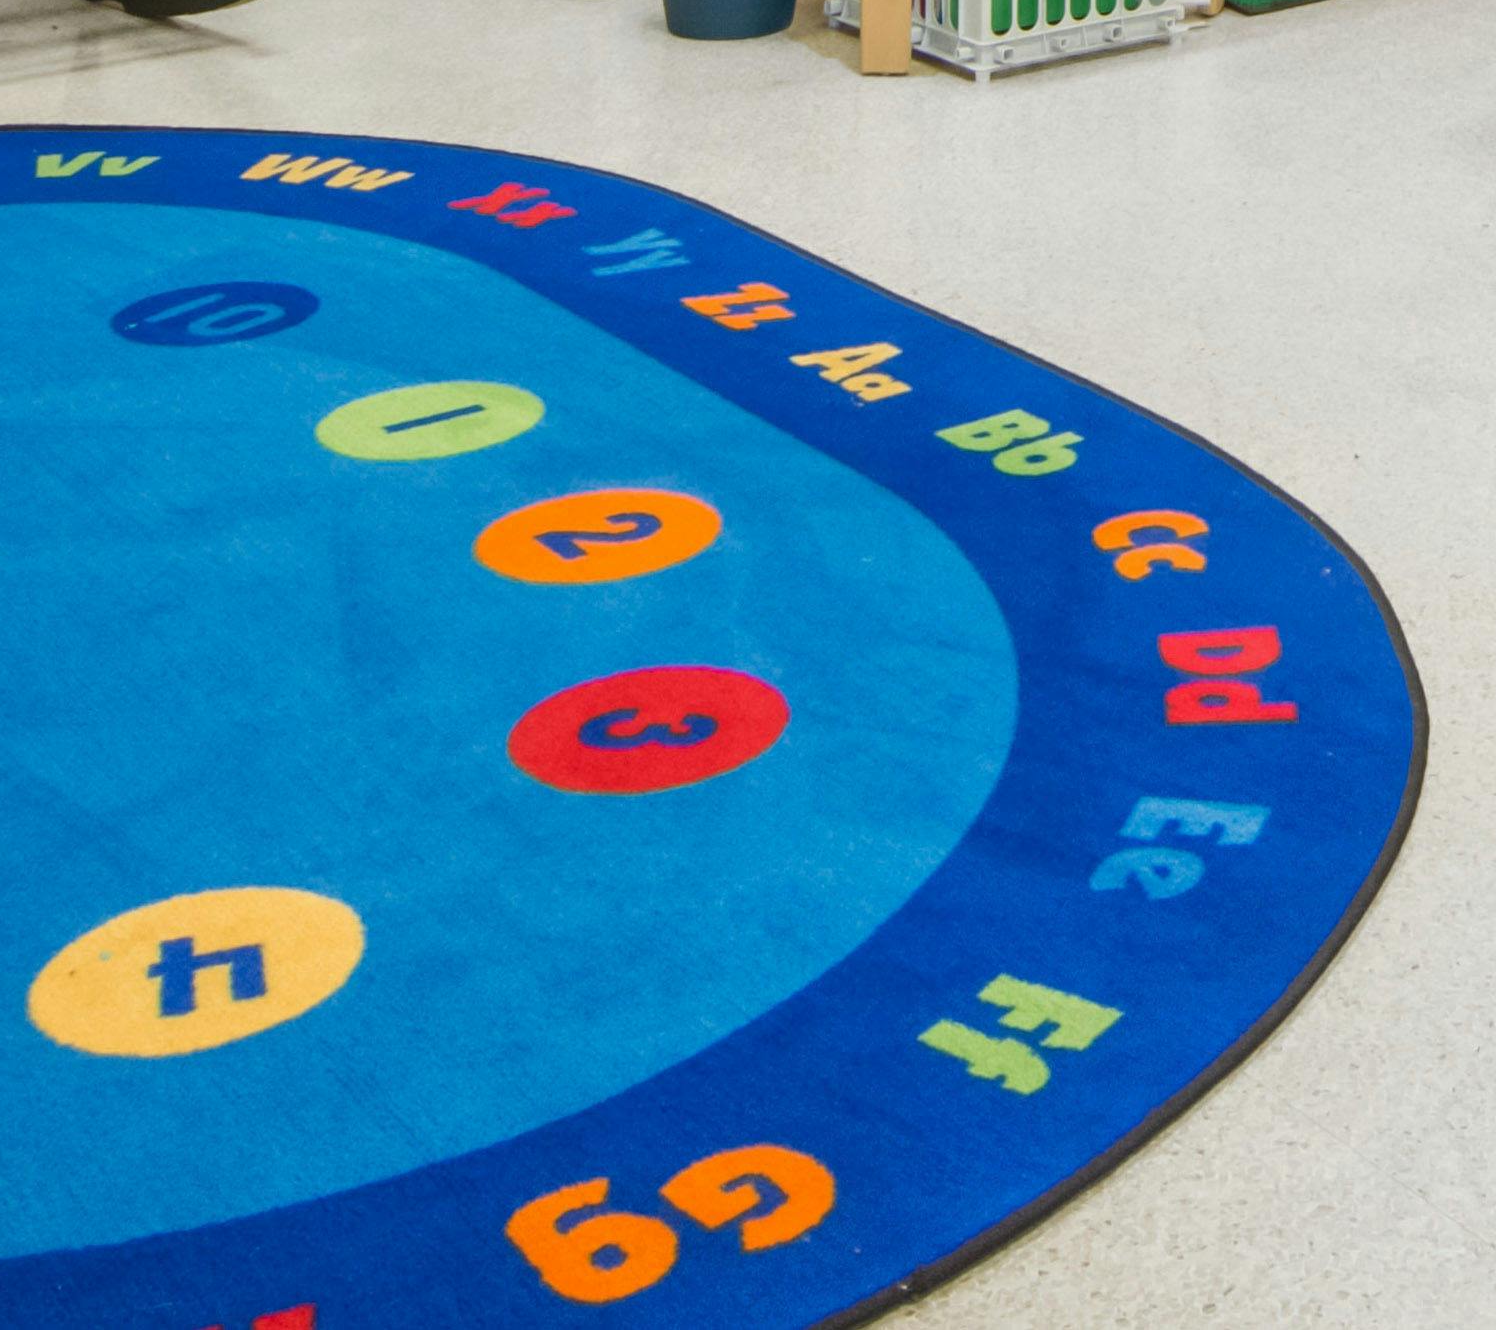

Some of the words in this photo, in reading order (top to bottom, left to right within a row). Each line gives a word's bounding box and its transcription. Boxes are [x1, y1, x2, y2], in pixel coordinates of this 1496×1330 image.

[34, 150, 161, 180] Vv
[239, 152, 418, 195] Ww
[447, 180, 579, 229] Xx
[582, 226, 694, 278] Yy
[138, 286, 282, 338] 10
[679, 280, 797, 331] Zz
[789, 340, 914, 404] Aa
[383, 403, 488, 438] 1
[933, 408, 1081, 477] Bb
[533, 510, 665, 561] 2
[1091, 507, 1211, 582] Cc
[1158, 624, 1300, 726] Dd
[577, 706, 720, 753] 3
[1087, 795, 1273, 901] Ee
[146, 934, 270, 1020] 4
[915, 971, 1126, 1098] Ff
[503, 1143, 838, 1307] Gg
